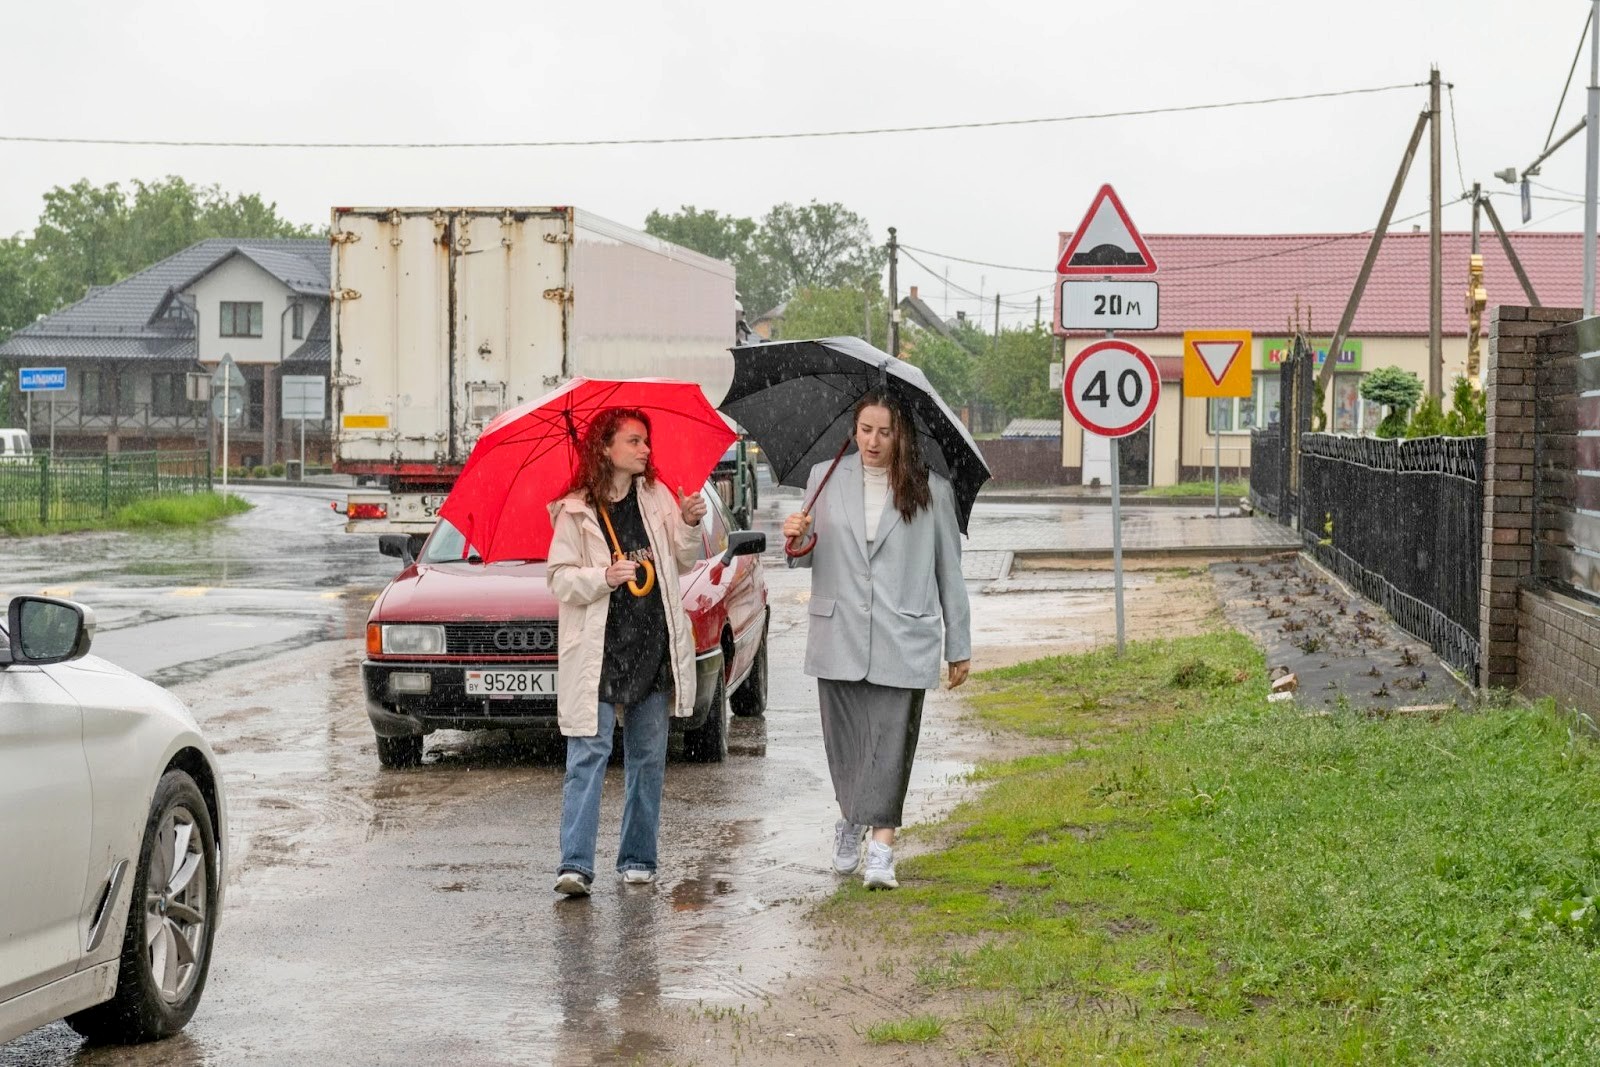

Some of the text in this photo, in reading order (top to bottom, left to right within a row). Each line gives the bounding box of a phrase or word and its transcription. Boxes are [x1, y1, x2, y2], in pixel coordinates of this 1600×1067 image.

[1094, 294, 1122, 315] 20
[1081, 368, 1143, 408] 40
[468, 683, 479, 692] BY
